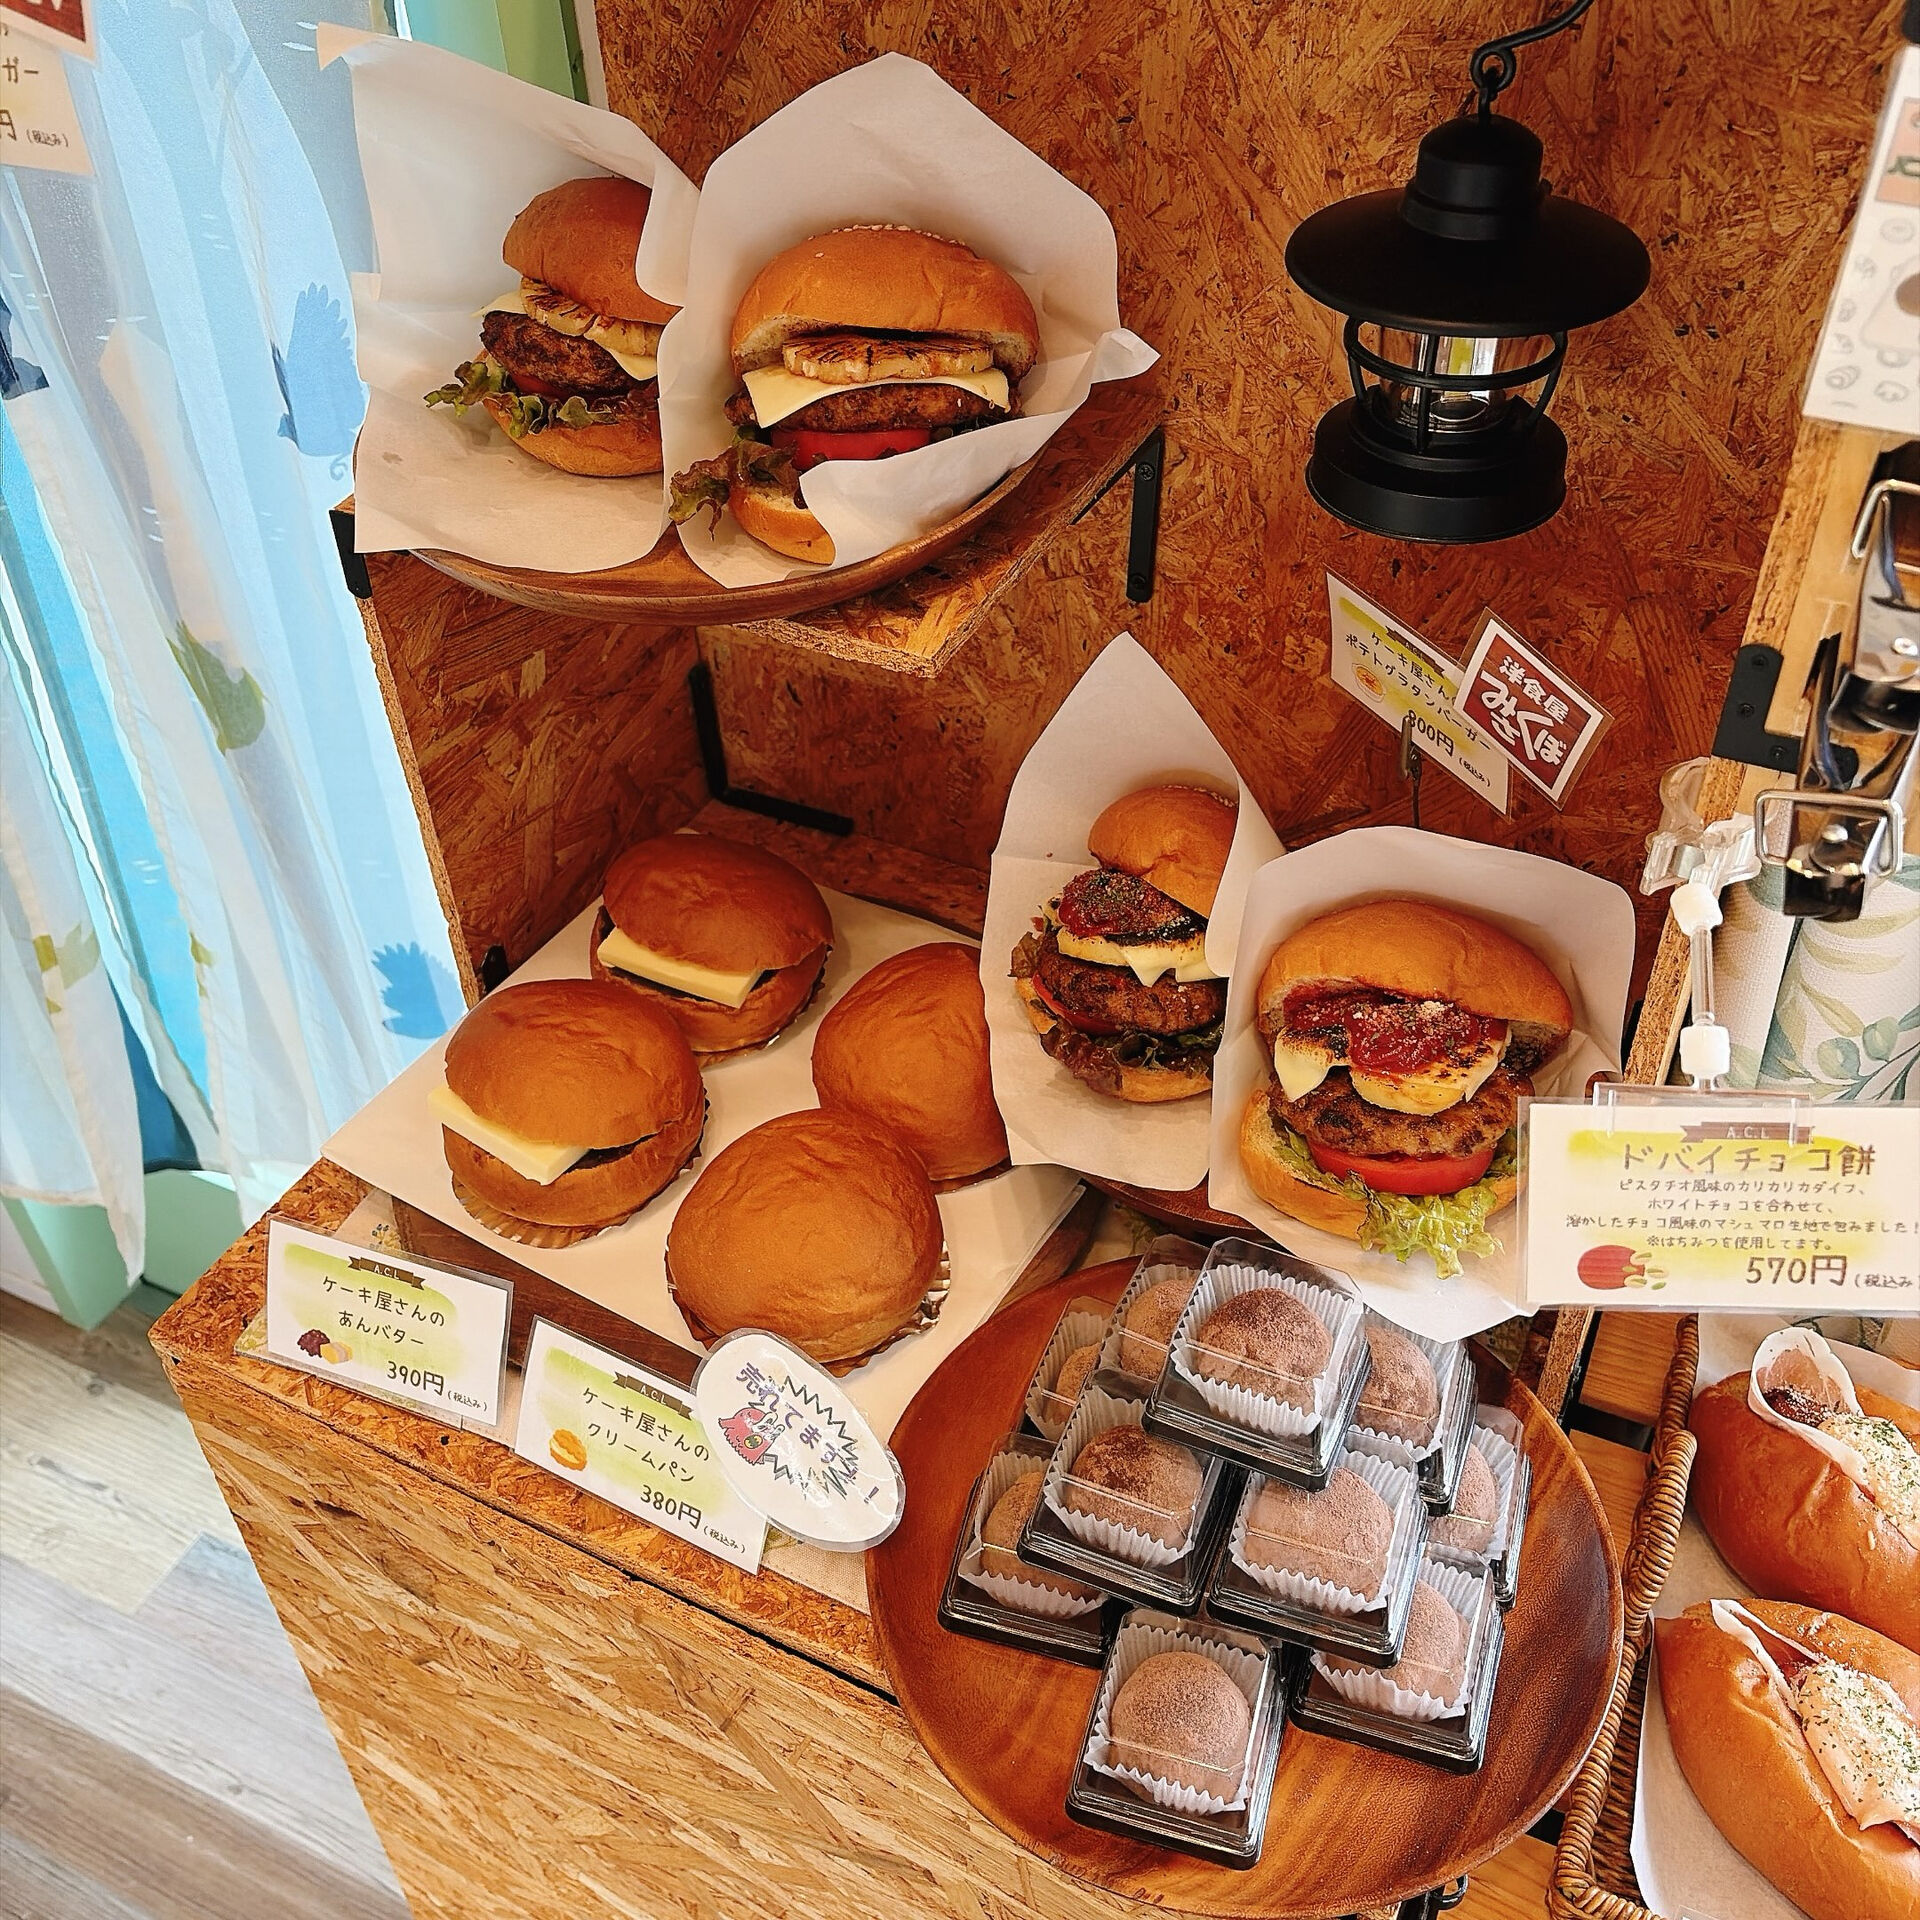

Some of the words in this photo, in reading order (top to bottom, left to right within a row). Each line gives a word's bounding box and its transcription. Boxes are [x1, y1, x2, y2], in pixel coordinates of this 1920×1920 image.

[1345, 633, 1491, 751] ポテトグラタンバーガー
[1499, 655, 1570, 724] 洋食屋
[1408, 709, 1454, 757] 800円
[1726, 1126, 1770, 1139] A.C.L
[1624, 1142, 1876, 1177] ドバイチョコ餅
[1647, 1198, 1834, 1214] ホワイトチョコを合わせて、
[373, 1264, 400, 1280] A.C.L
[1745, 1254, 1848, 1287] 570円
[322, 1275, 445, 1328] ケーキ屋さんの
[338, 1309, 425, 1346] あんバター
[386, 1360, 445, 1396] 390円
[447, 1389, 488, 1412] (税込み)
[639, 1384, 668, 1405] A.C.L
[582, 1386, 710, 1462] ケーキ屋さんの
[587, 1422, 695, 1483] クリームパン
[640, 1484, 701, 1530] 380円
[703, 1524, 746, 1555] (税込み)
